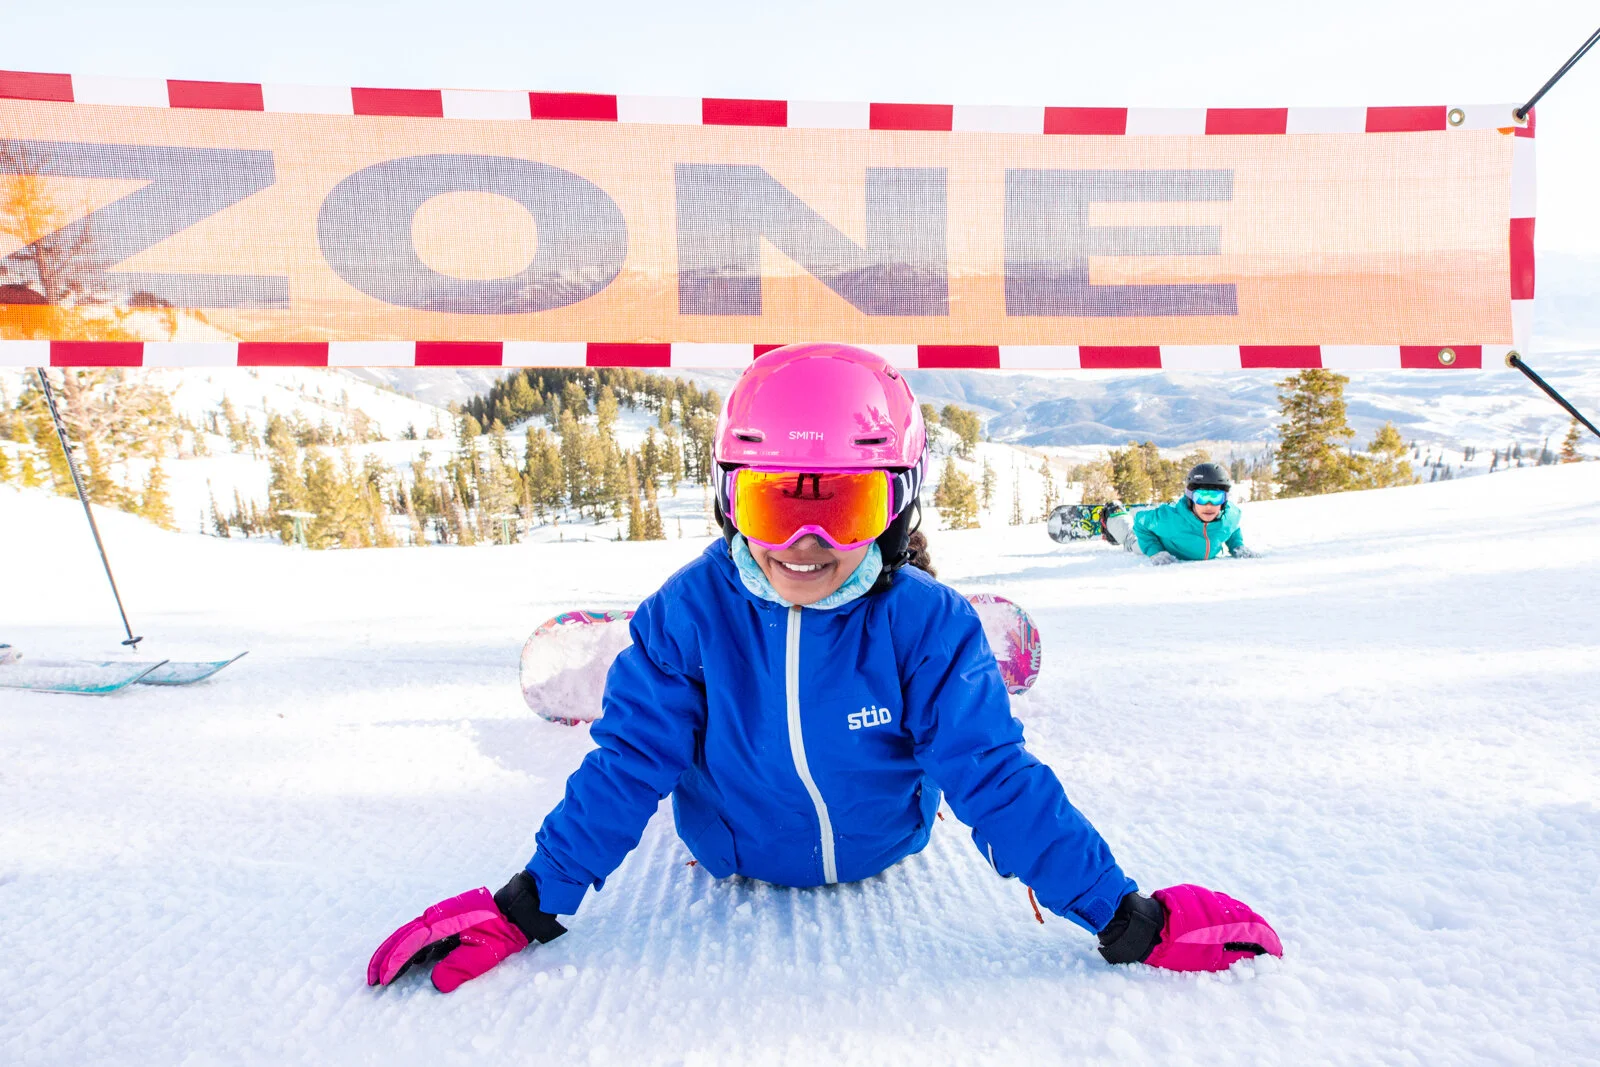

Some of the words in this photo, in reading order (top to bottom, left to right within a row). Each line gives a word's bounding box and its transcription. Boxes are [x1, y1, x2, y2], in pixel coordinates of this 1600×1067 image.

[0, 138, 1239, 317] ZONE
[788, 431, 824, 441] SMITH
[847, 705, 892, 730] stio
